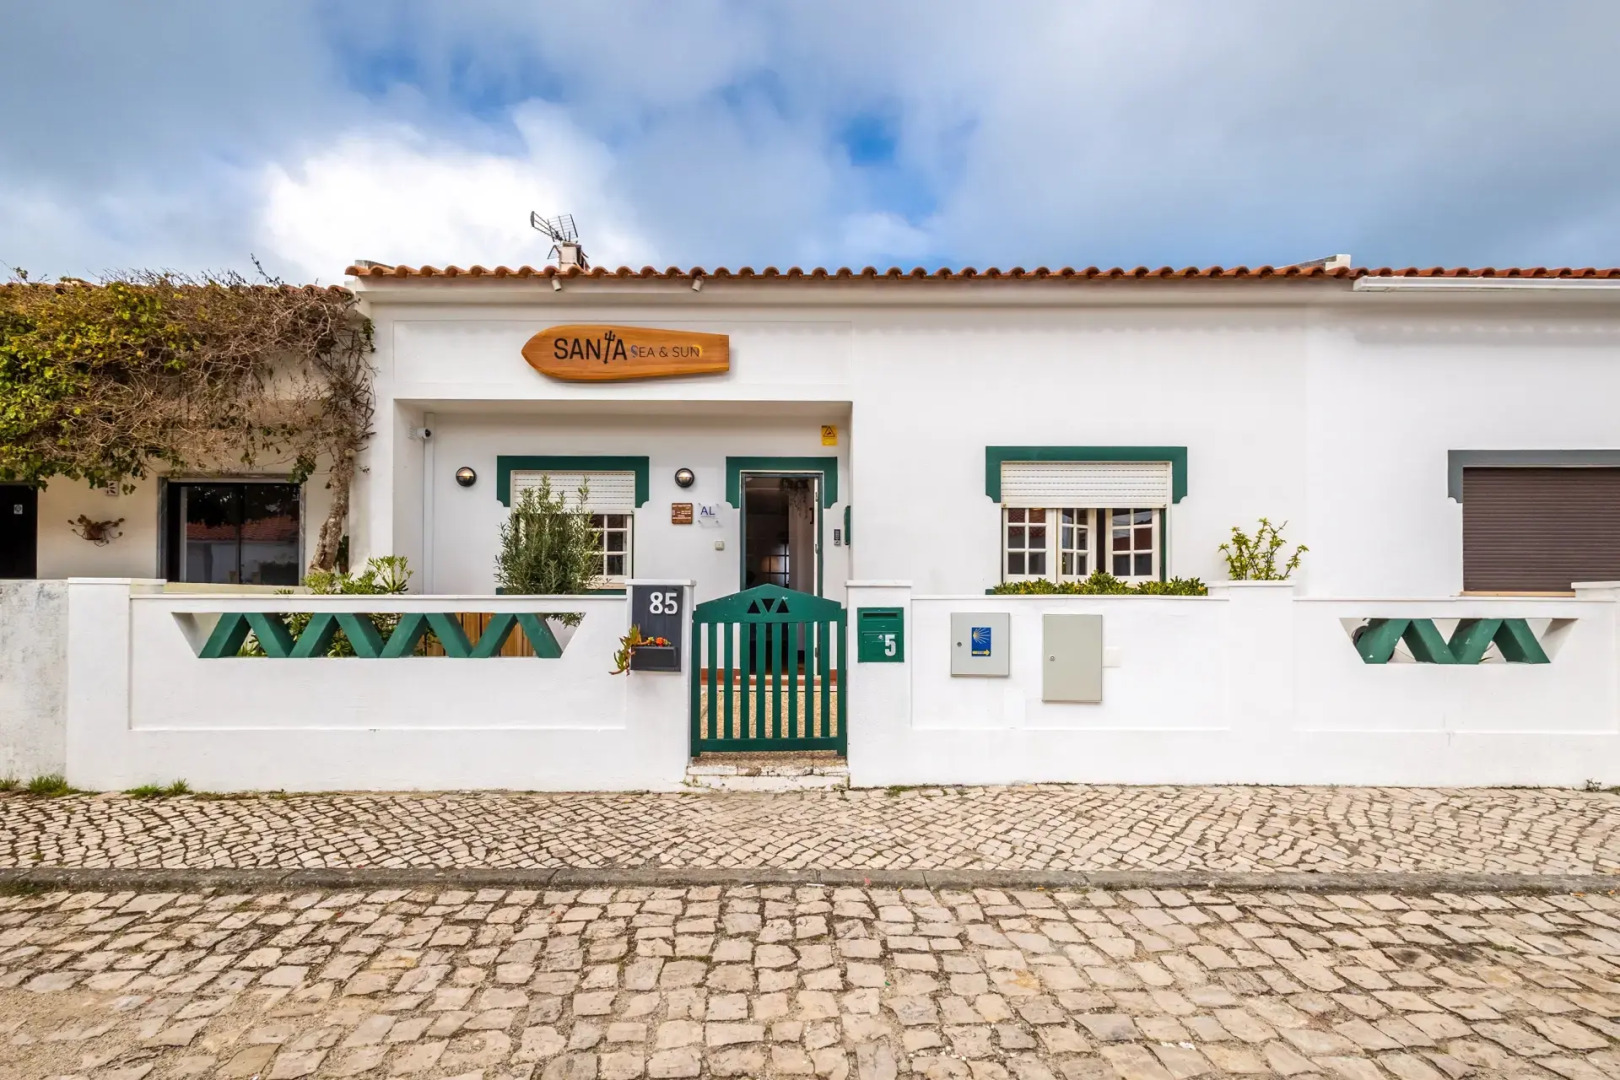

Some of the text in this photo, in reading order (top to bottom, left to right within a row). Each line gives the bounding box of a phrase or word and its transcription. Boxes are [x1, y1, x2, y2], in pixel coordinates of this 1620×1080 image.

[554, 331, 702, 365] SANTA SEA & SUN
[700, 506, 716, 516] AL
[649, 591, 678, 615] 85
[884, 634, 897, 657] 5
